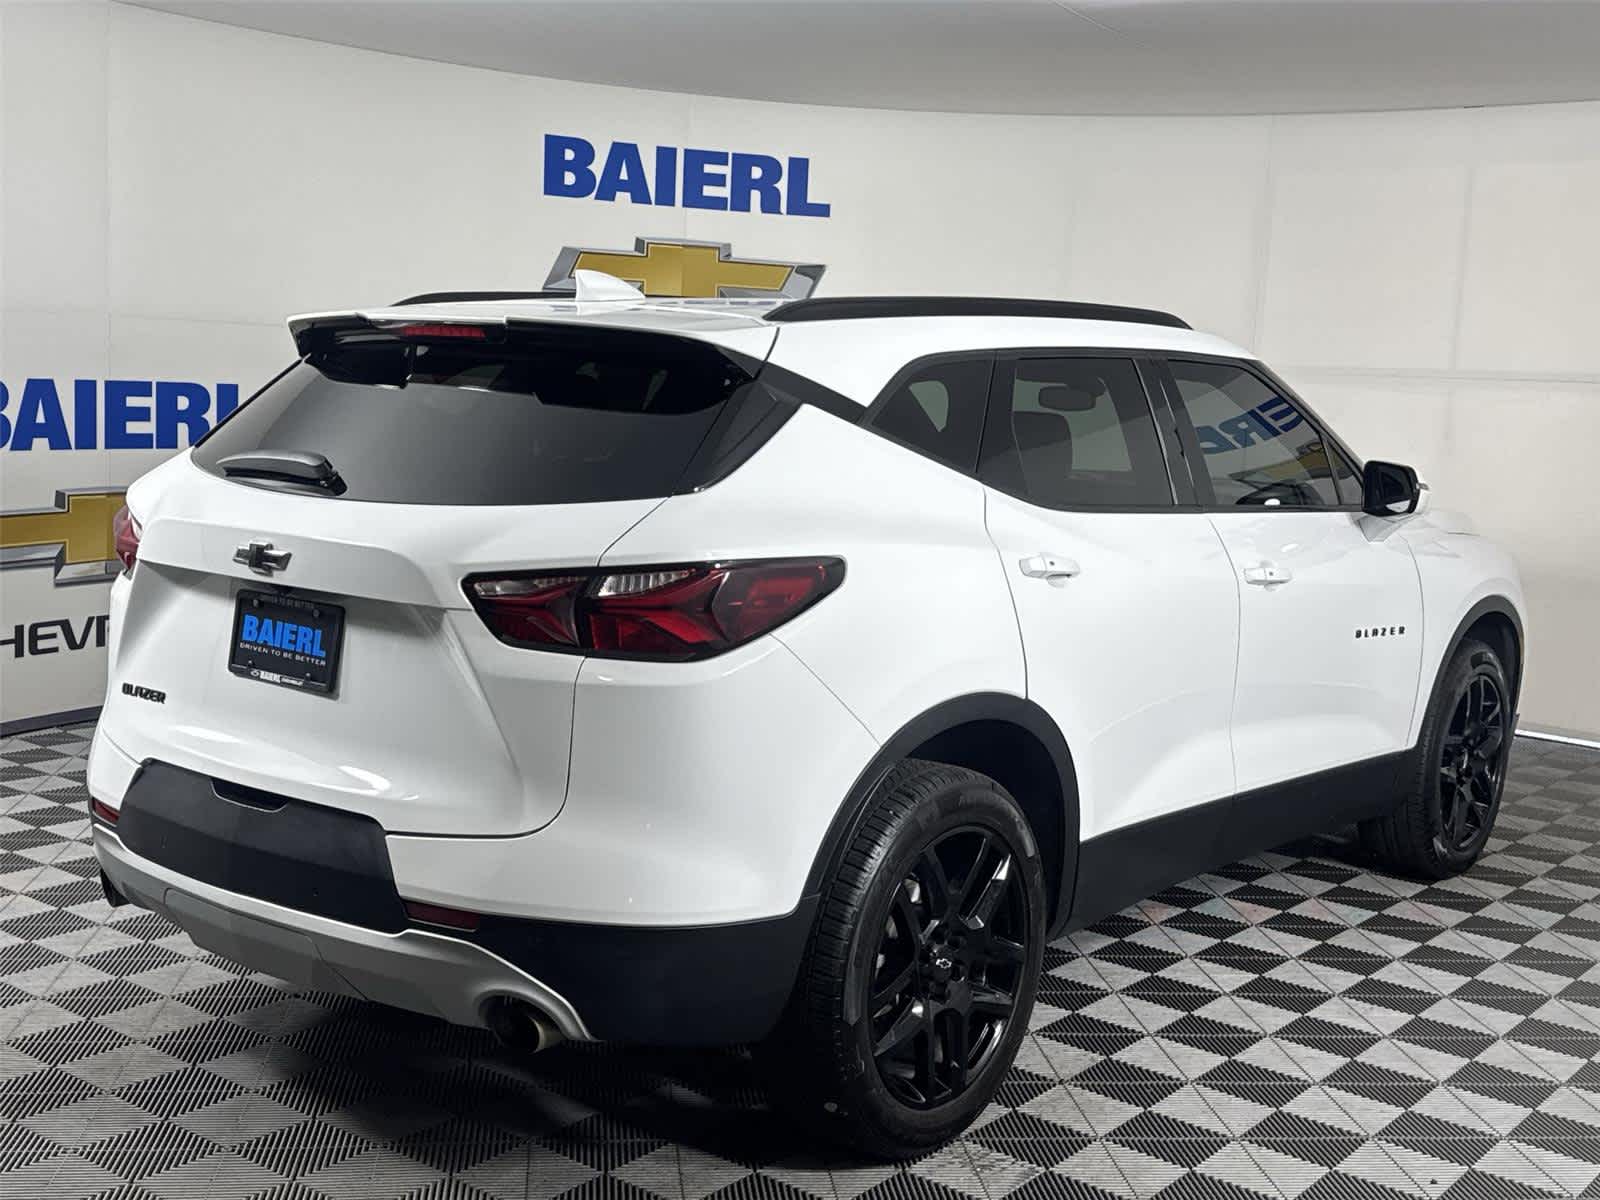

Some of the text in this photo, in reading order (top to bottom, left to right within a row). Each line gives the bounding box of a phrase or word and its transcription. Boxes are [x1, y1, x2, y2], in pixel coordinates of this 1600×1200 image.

[544, 134, 831, 218] BAIERL
[0, 378, 239, 451] AIER
[242, 614, 326, 657] BAIERL
[1355, 626, 1406, 639] BLAZER
[240, 642, 326, 666] DRIVEN TO BE BETTER
[122, 682, 166, 704] BLAZER
